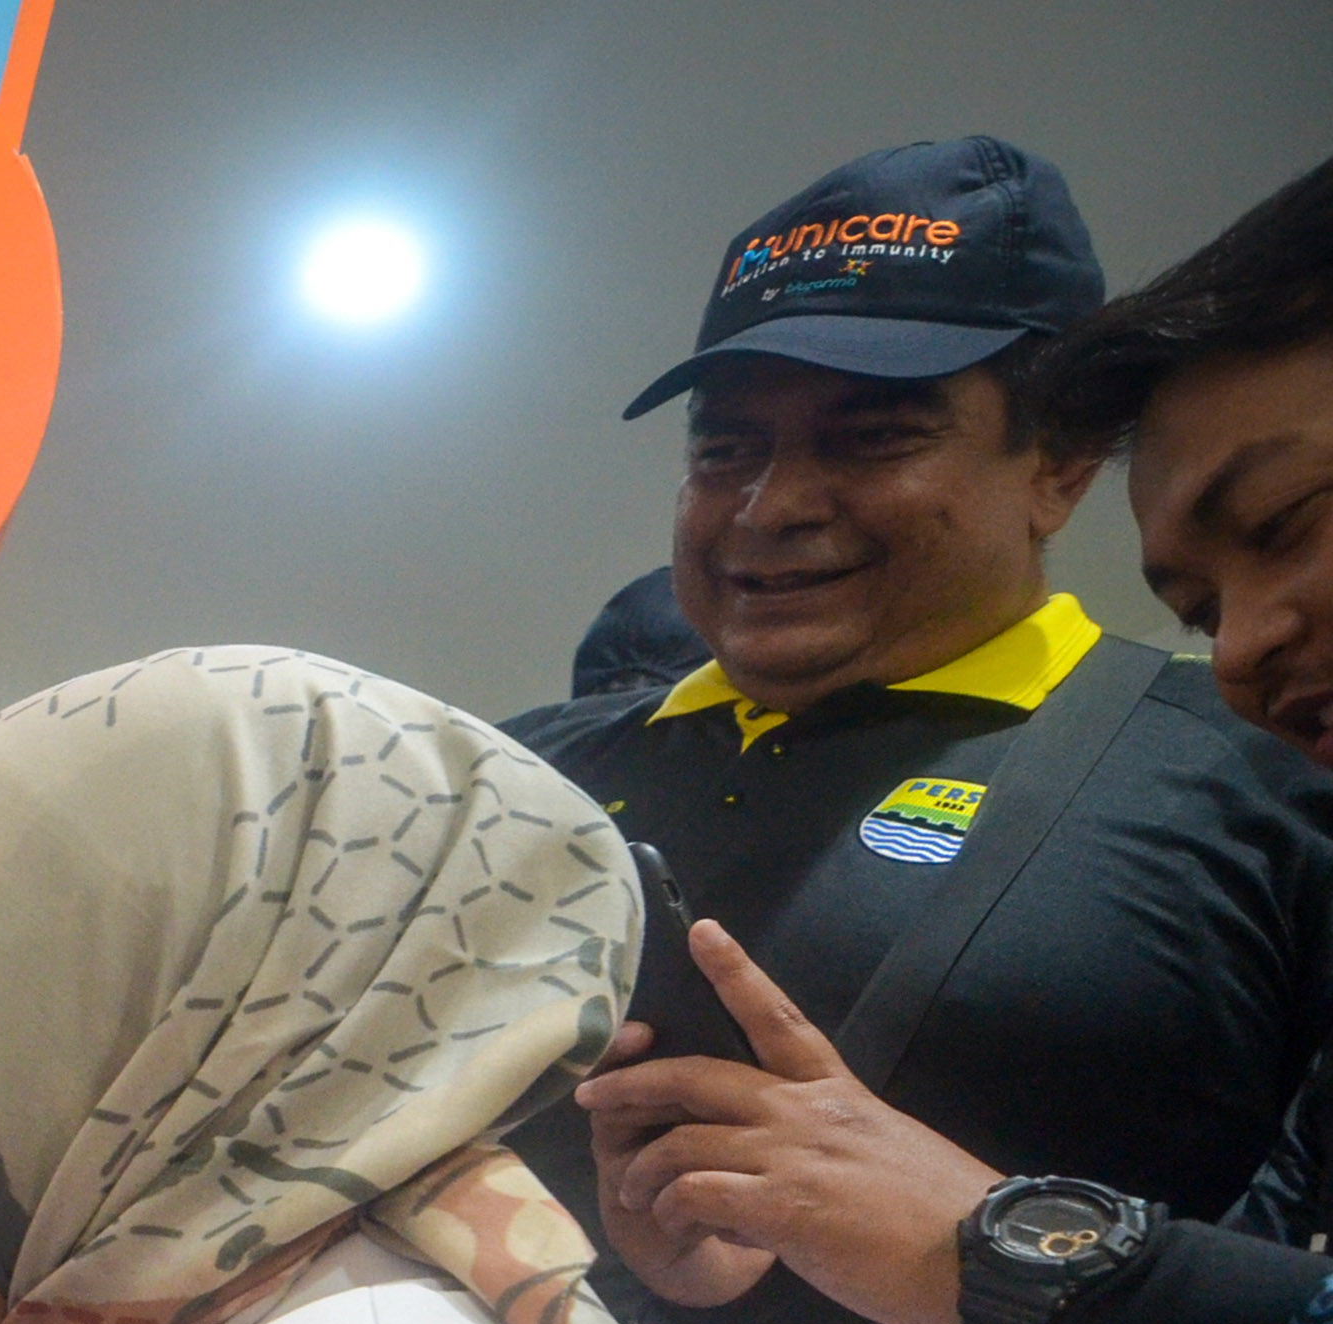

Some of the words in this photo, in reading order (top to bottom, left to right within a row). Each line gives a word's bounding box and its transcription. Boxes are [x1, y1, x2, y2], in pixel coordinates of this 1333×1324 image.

[802, 248, 827, 261] to
[841, 243, 954, 264] immunity
[908, 781, 984, 804] PERS
